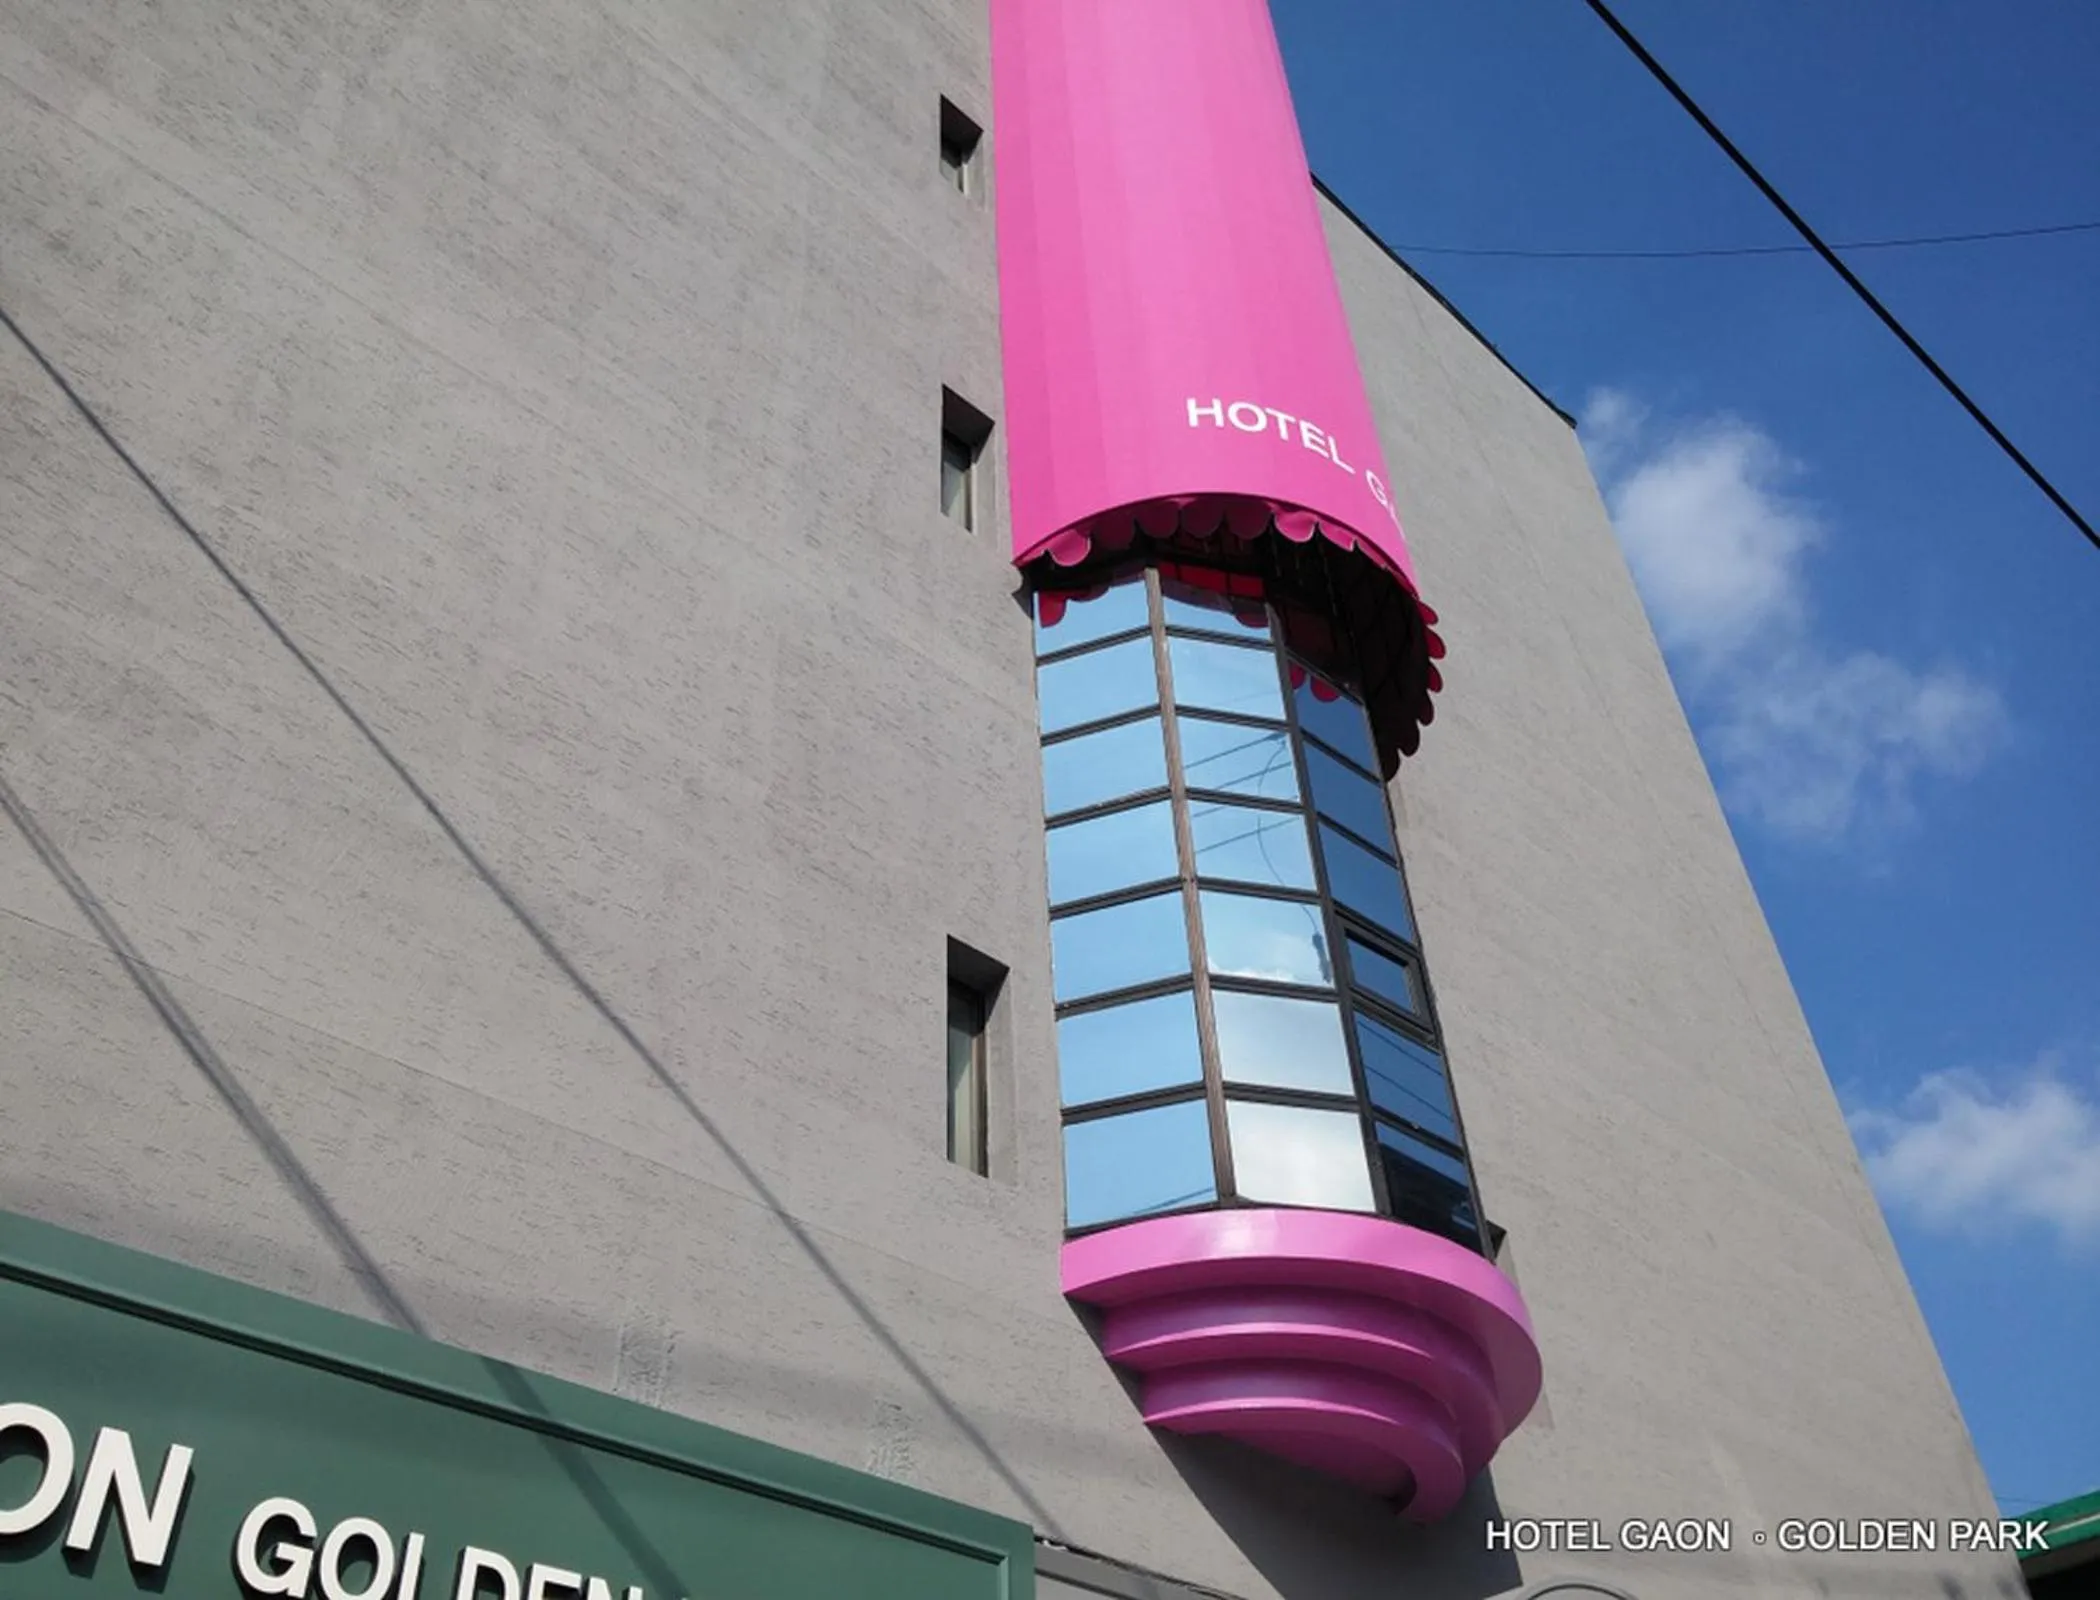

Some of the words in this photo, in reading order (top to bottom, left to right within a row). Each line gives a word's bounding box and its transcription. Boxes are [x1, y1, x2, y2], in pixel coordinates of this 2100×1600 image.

[1186, 397, 1356, 475] HOTEL
[0, 1402, 194, 1566] ON
[237, 1496, 644, 1600] GOLD
